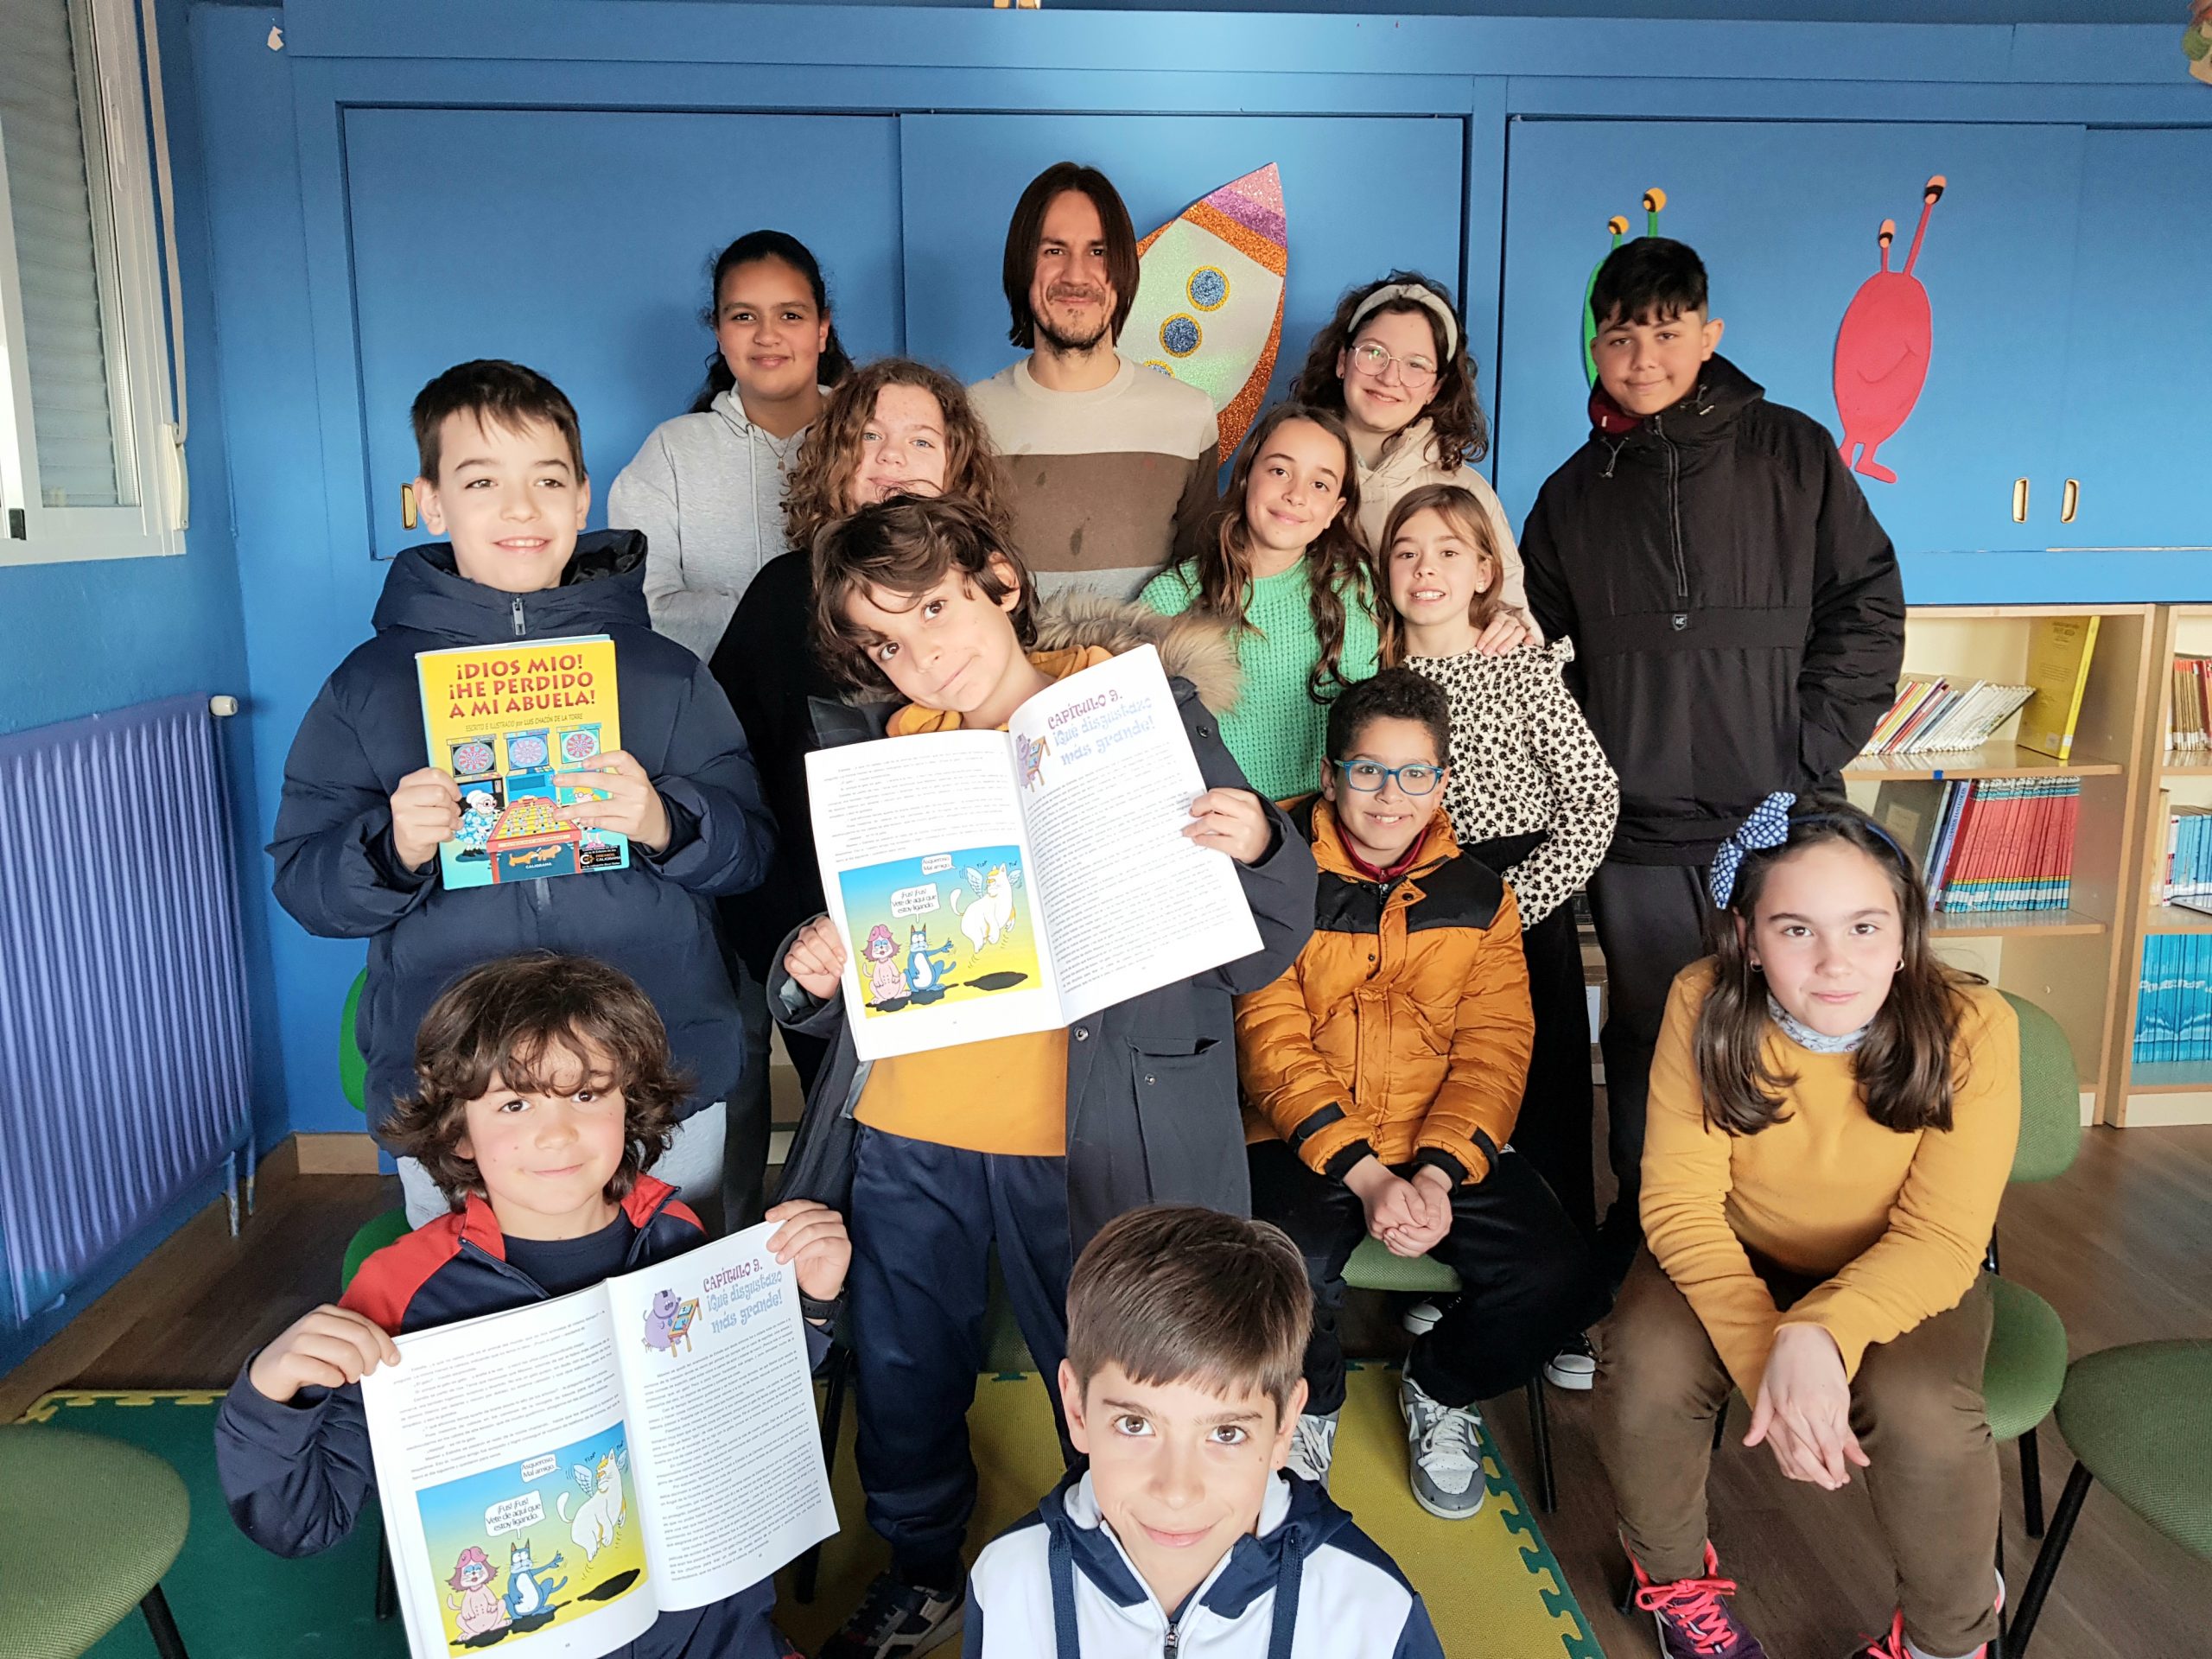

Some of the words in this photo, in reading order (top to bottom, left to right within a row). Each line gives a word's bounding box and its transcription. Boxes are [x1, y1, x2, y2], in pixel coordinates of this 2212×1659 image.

[457, 659, 520, 680] ¡DIOS
[527, 654, 582, 673] MIO!
[448, 681, 486, 700] ¡HE
[493, 671, 594, 696] PERDIDO
[448, 703, 466, 718] A
[471, 699, 499, 716] MI
[505, 690, 595, 713] ABUELA!
[1048, 694, 1106, 730] CAPÍTULO
[1109, 690, 1123, 702] 9.
[535, 715, 554, 725] CHACÓN
[1052, 723, 1079, 747] ¡Qué
[1081, 697, 1152, 734] disgustazo
[1060, 744, 1091, 766] más
[1096, 715, 1155, 753] grande!
[898, 905, 912, 913] estoy
[702, 1262, 751, 1293] CAPÍTULO
[753, 1258, 763, 1272] 9.
[707, 1288, 728, 1312] ¡Qué
[730, 1270, 782, 1300] disgustazo
[711, 1311, 737, 1333] más
[740, 1287, 783, 1325] grande!
[523, 1470, 535, 1478] Mal
[486, 1515, 502, 1525] Vete
[512, 1509, 527, 1519] aquí
[528, 1503, 542, 1513] que
[498, 1503, 512, 1514] ¡Fus!
[513, 1497, 529, 1510] ¡Fus!
[493, 1521, 512, 1532] estoy
[512, 1513, 538, 1528] ligando.
